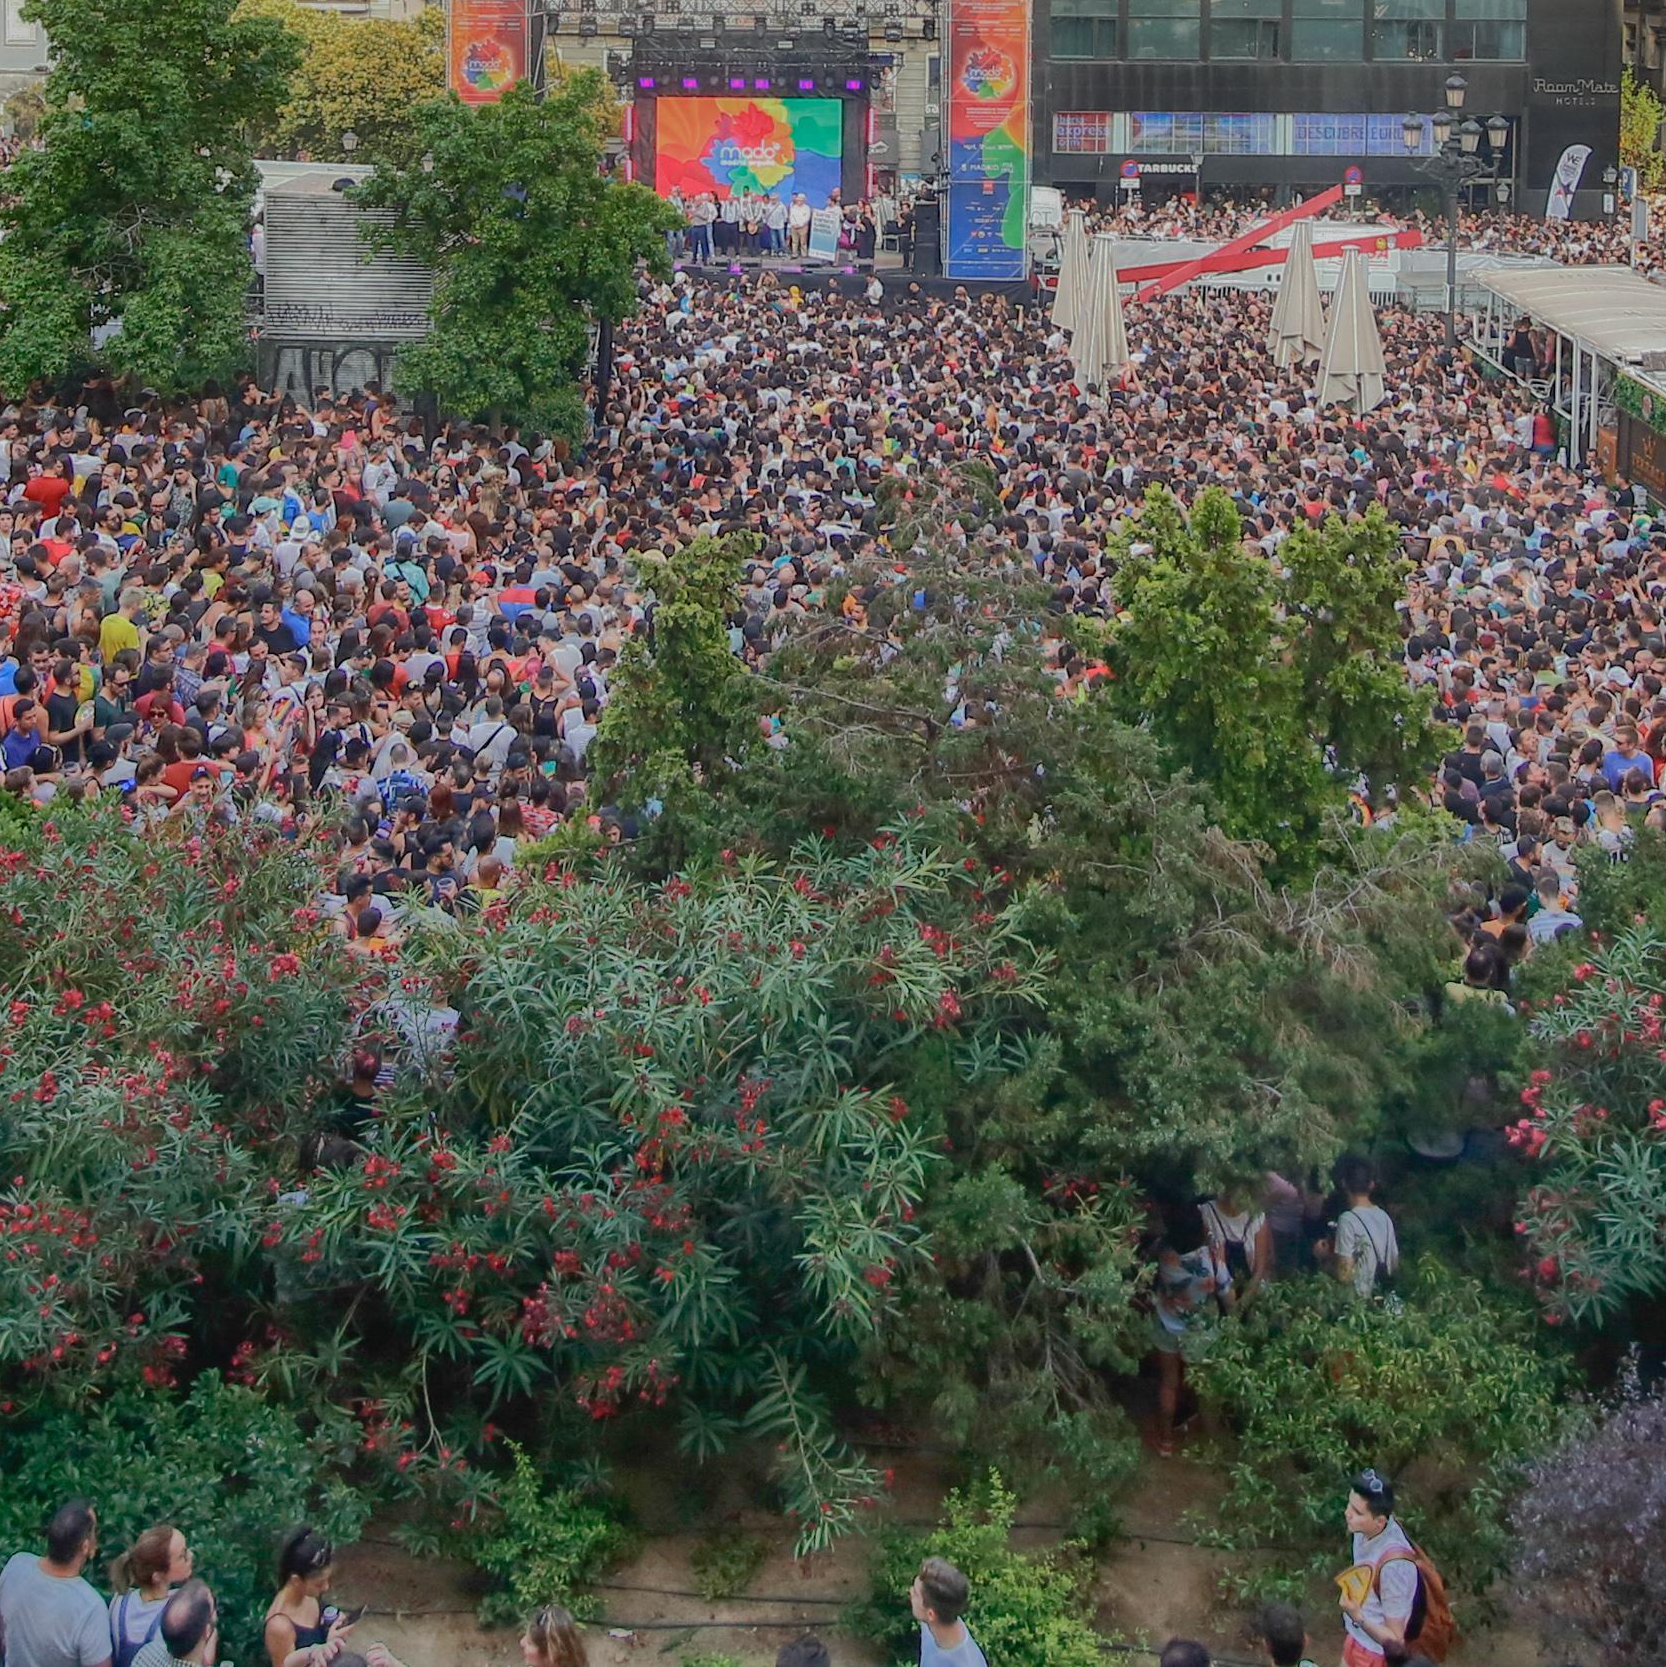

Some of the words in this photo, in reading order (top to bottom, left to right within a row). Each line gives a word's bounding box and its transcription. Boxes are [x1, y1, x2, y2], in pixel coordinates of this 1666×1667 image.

[1056, 126, 1111, 139] express
[1296, 126, 1364, 140] DESCUBRE
[720, 138, 776, 160] mado
[1136, 163, 1199, 174] TARBUCKS
